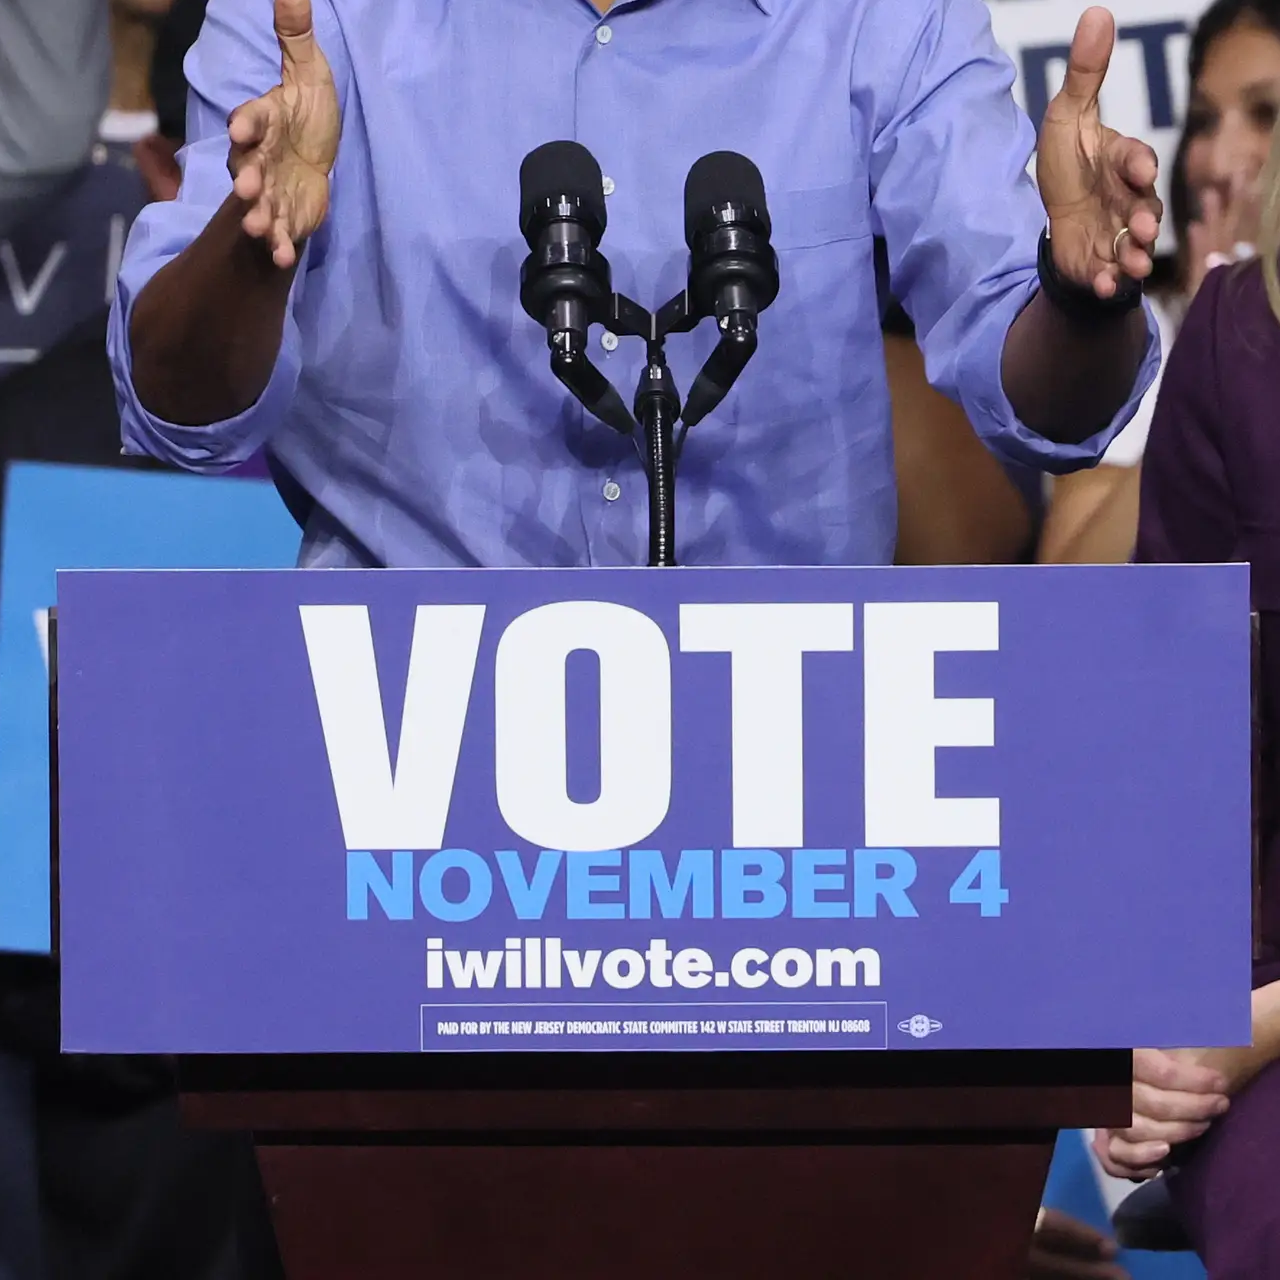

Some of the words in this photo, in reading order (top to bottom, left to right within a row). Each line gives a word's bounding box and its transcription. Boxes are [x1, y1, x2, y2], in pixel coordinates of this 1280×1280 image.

[299, 600, 1000, 852] VOTE
[346, 850, 920, 922] NOVEMBER
[948, 850, 1010, 918] 4
[426, 937, 881, 990] iwillvote.com
[437, 1021, 458, 1035] PAID
[461, 1020, 478, 1034] FOR
[480, 1020, 492, 1034] BY
[493, 1020, 510, 1034] THE
[512, 1020, 532, 1034] NEW
[534, 1020, 565, 1034] JERSEY
[567, 1020, 621, 1034] DEMOCRATIC
[623, 1020, 648, 1034] STATE
[650, 1020, 698, 1034] COMMITTEE
[700, 1019, 715, 1033] 142
[717, 1019, 727, 1033] W
[728, 1019, 753, 1033] STATE
[754, 1019, 785, 1033] STREET
[787, 1019, 826, 1033] TRENTON
[828, 1019, 840, 1033] NJ
